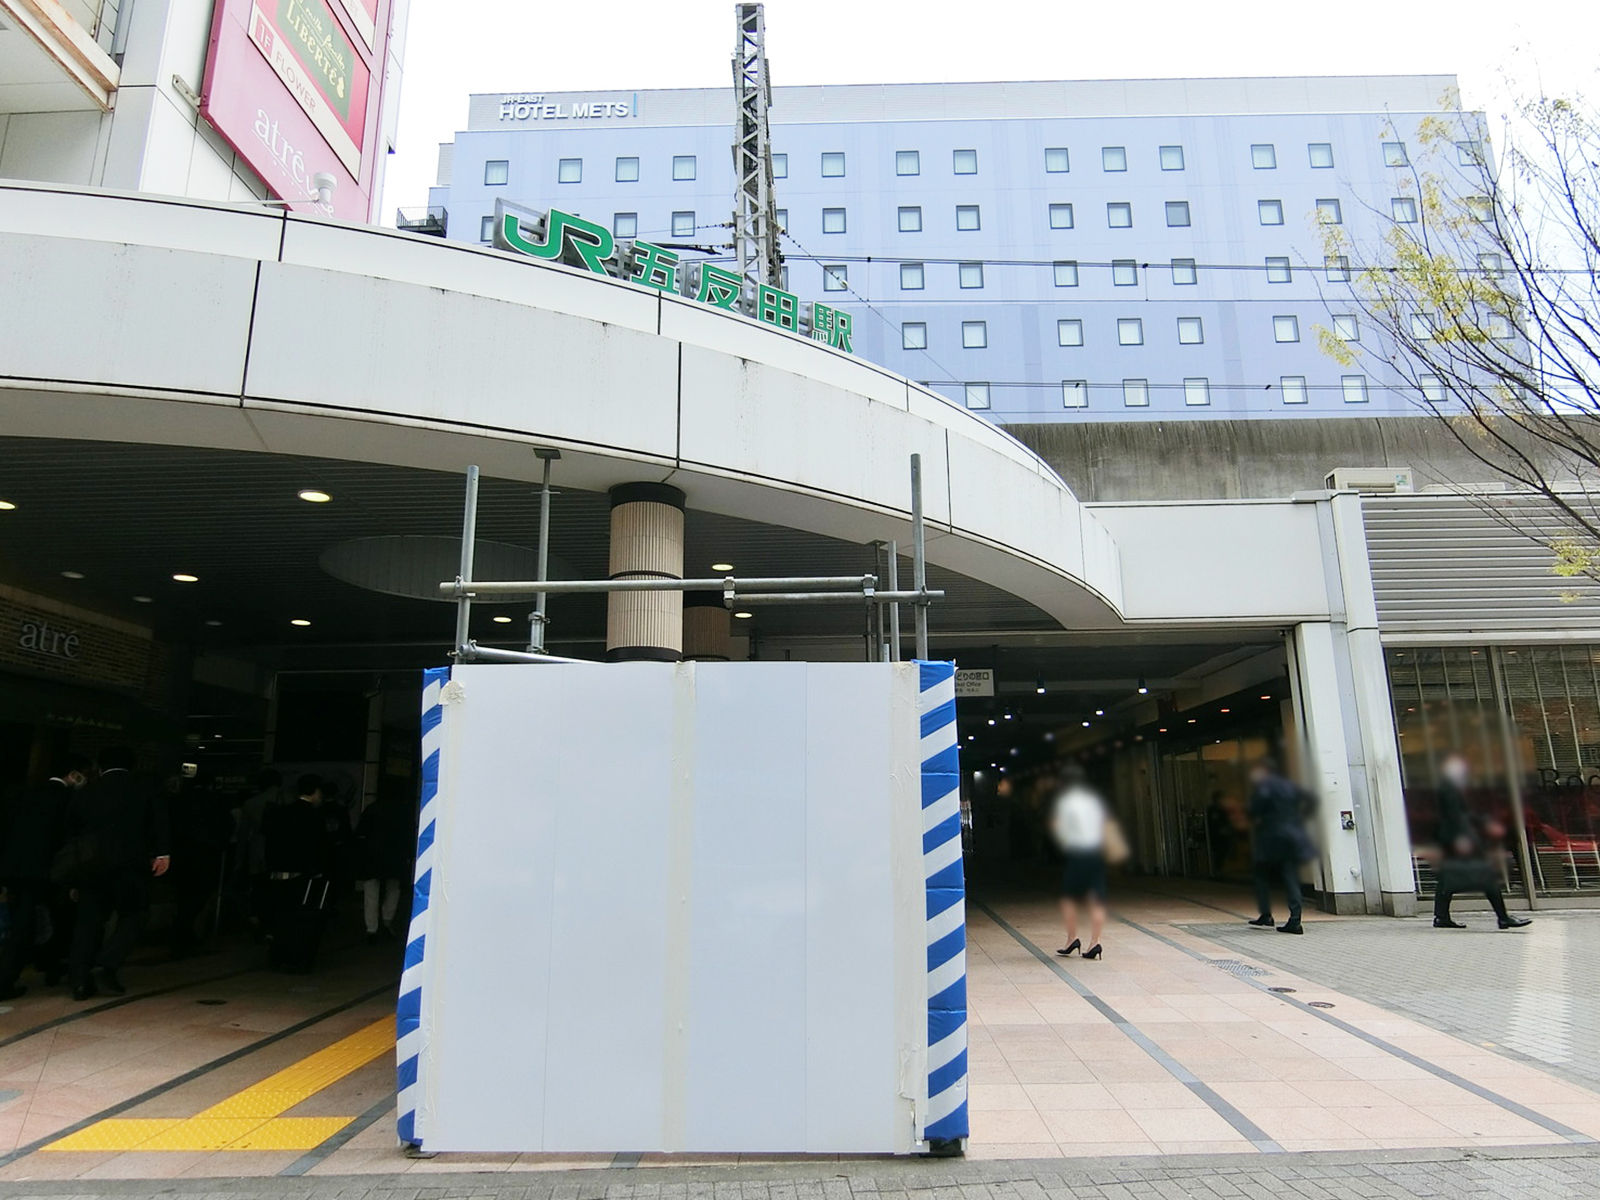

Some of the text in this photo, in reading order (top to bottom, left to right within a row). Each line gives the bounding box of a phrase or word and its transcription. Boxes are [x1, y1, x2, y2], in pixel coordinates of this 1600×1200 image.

[259, 23, 272, 49] 1F
[275, 51, 317, 114] FLOWER
[286, 0, 337, 85] LIBERTÉ
[499, 101, 629, 121] HOTEL METS
[501, 94, 544, 104] JR-EAST
[254, 108, 305, 184] atré
[19, 620, 80, 659] atré
